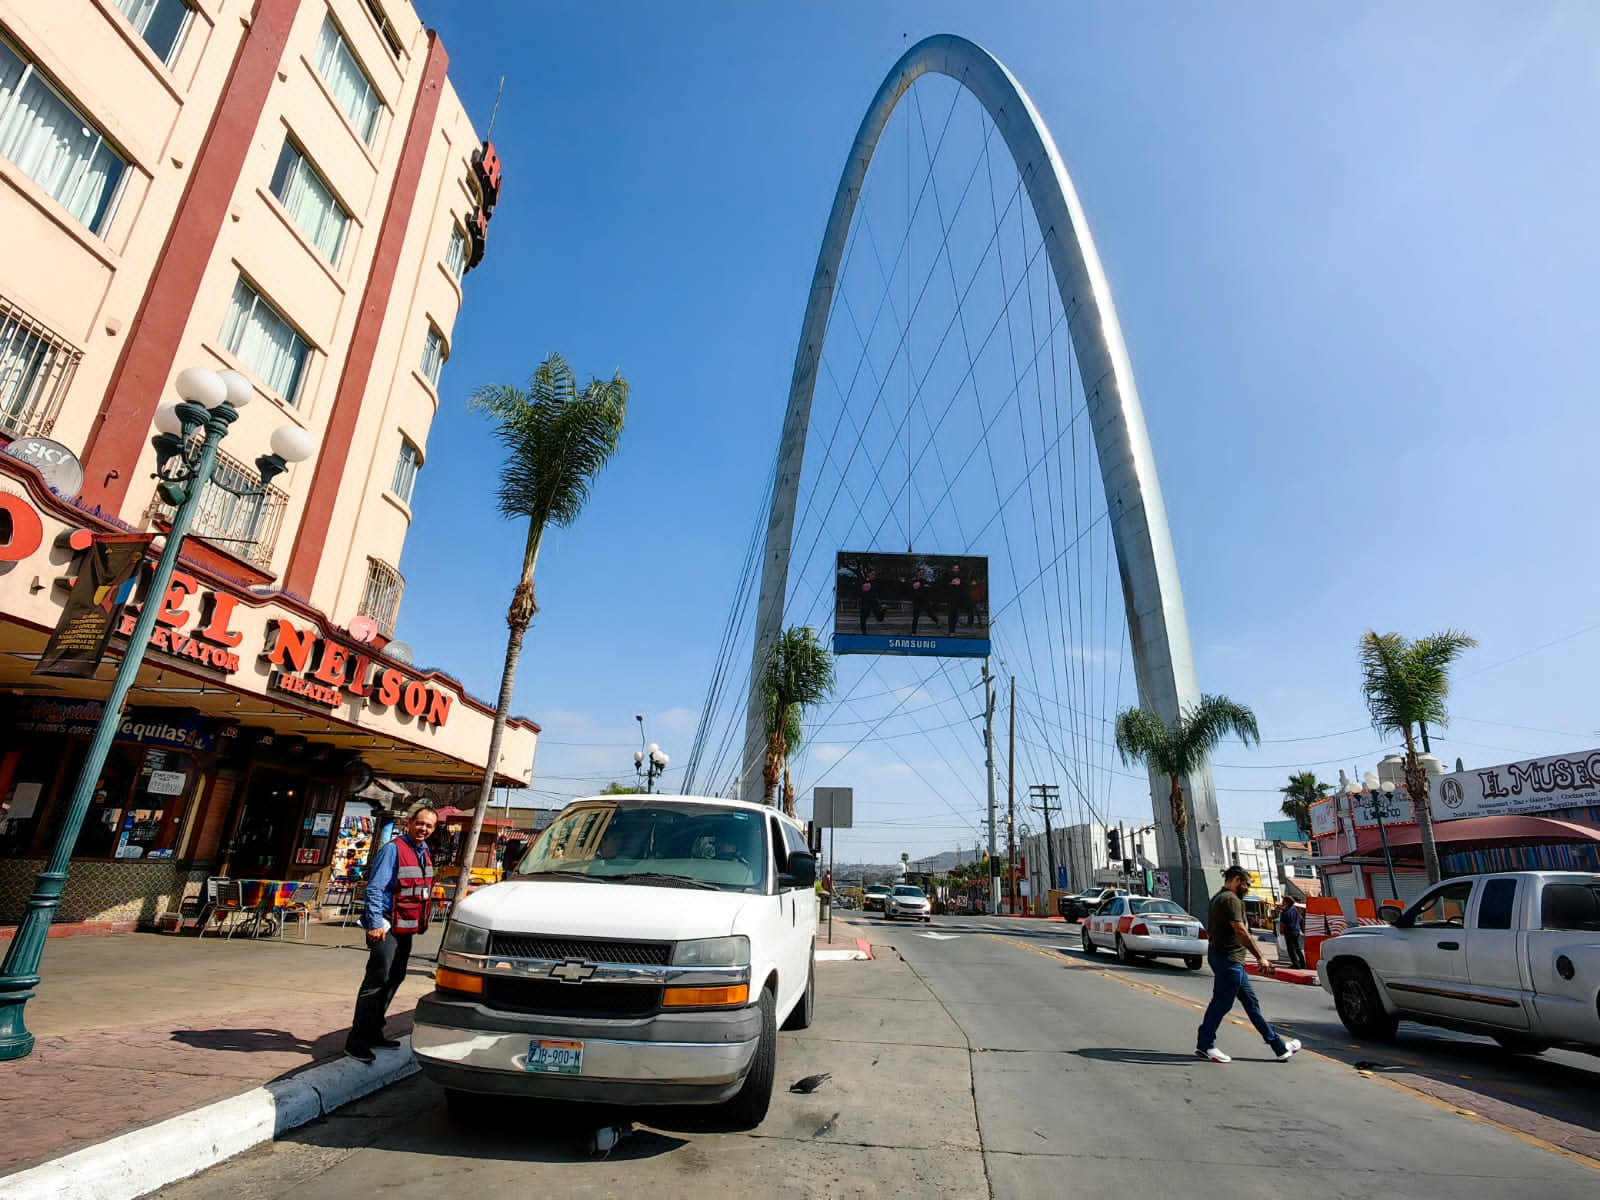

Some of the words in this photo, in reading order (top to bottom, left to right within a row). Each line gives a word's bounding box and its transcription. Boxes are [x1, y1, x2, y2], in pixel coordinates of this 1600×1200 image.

[119, 615, 240, 672] EEVATOR
[888, 639, 937, 649] SAMSUNG
[268, 619, 453, 728] NELSON
[280, 673, 343, 708] HEATER
[117, 716, 187, 743] Tequilas
[1478, 770, 1509, 799] EL
